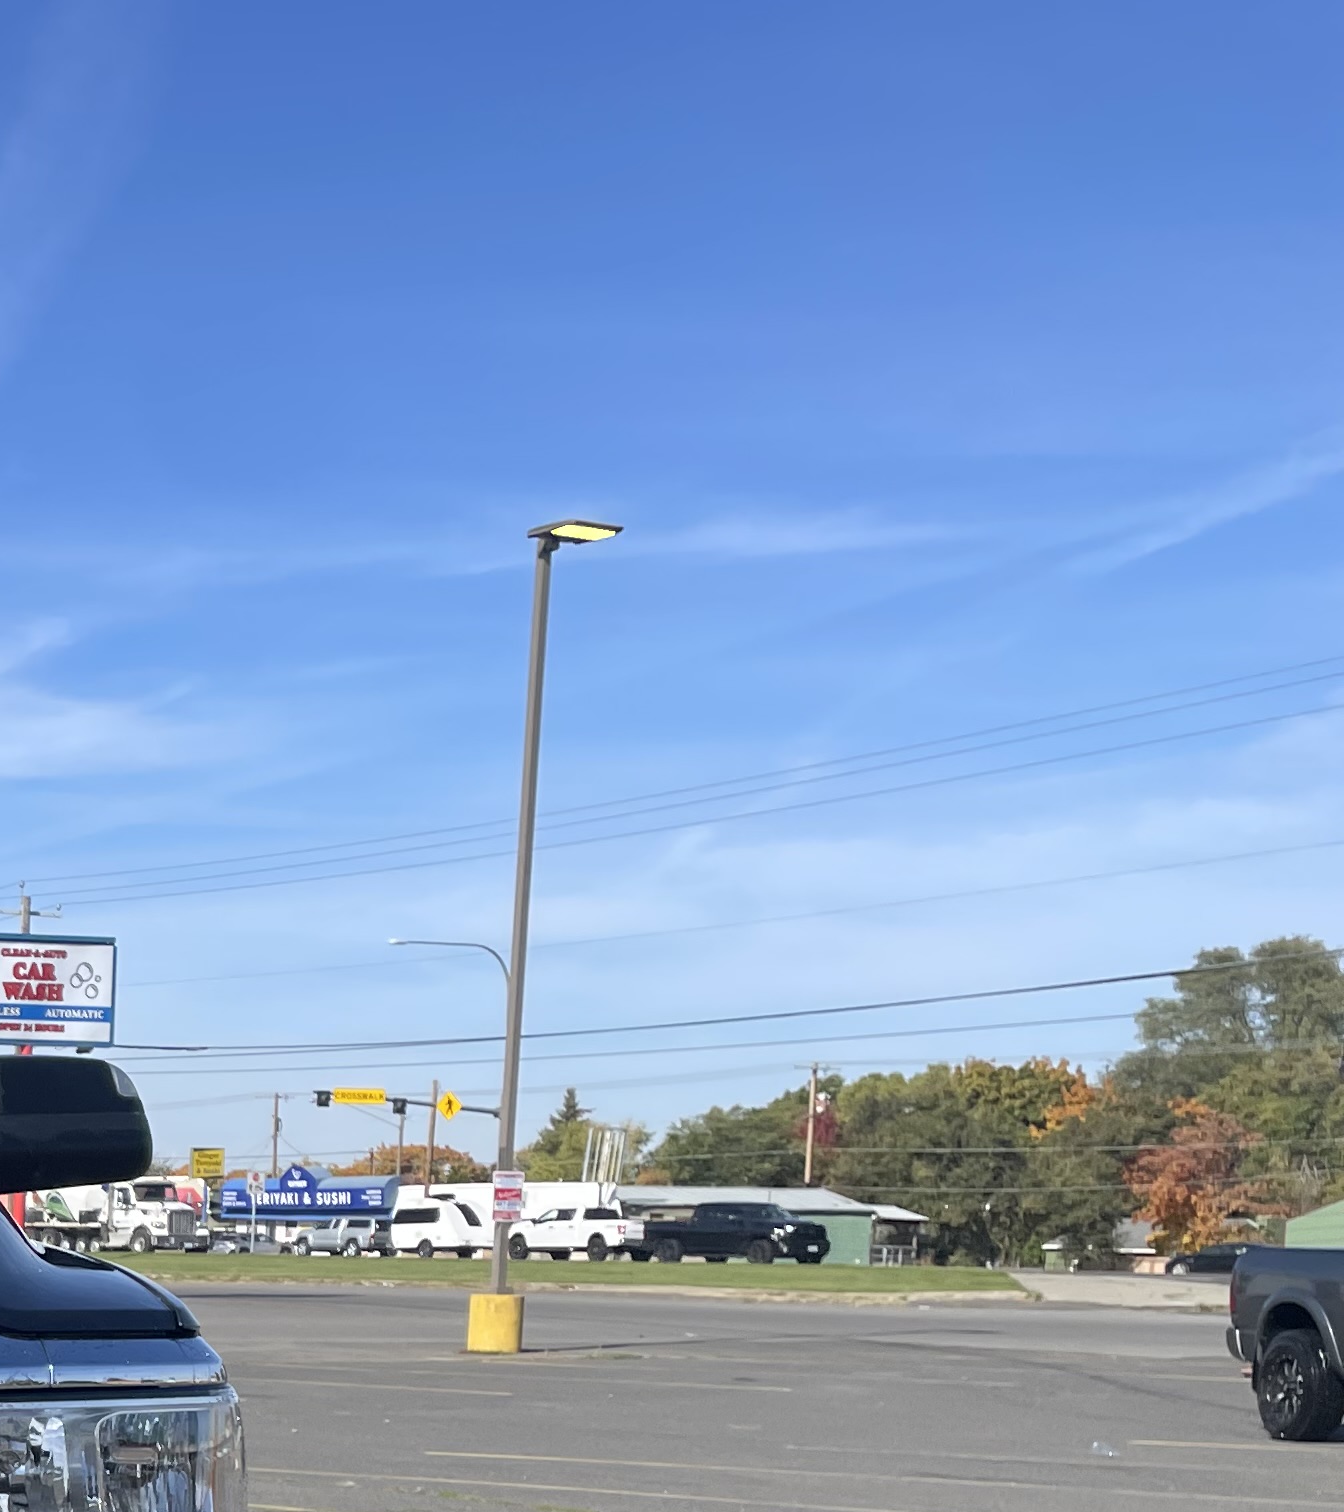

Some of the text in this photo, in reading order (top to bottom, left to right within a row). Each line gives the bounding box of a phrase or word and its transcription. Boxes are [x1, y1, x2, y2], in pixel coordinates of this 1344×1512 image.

[13, 962, 57, 981] CAR
[2, 982, 64, 1001] WASH
[45, 1008, 104, 1020] AUTOMATIC
[335, 1091, 385, 1100] CROSSWALK
[303, 1192, 311, 1205] &
[316, 1191, 352, 1205] SUSHI
